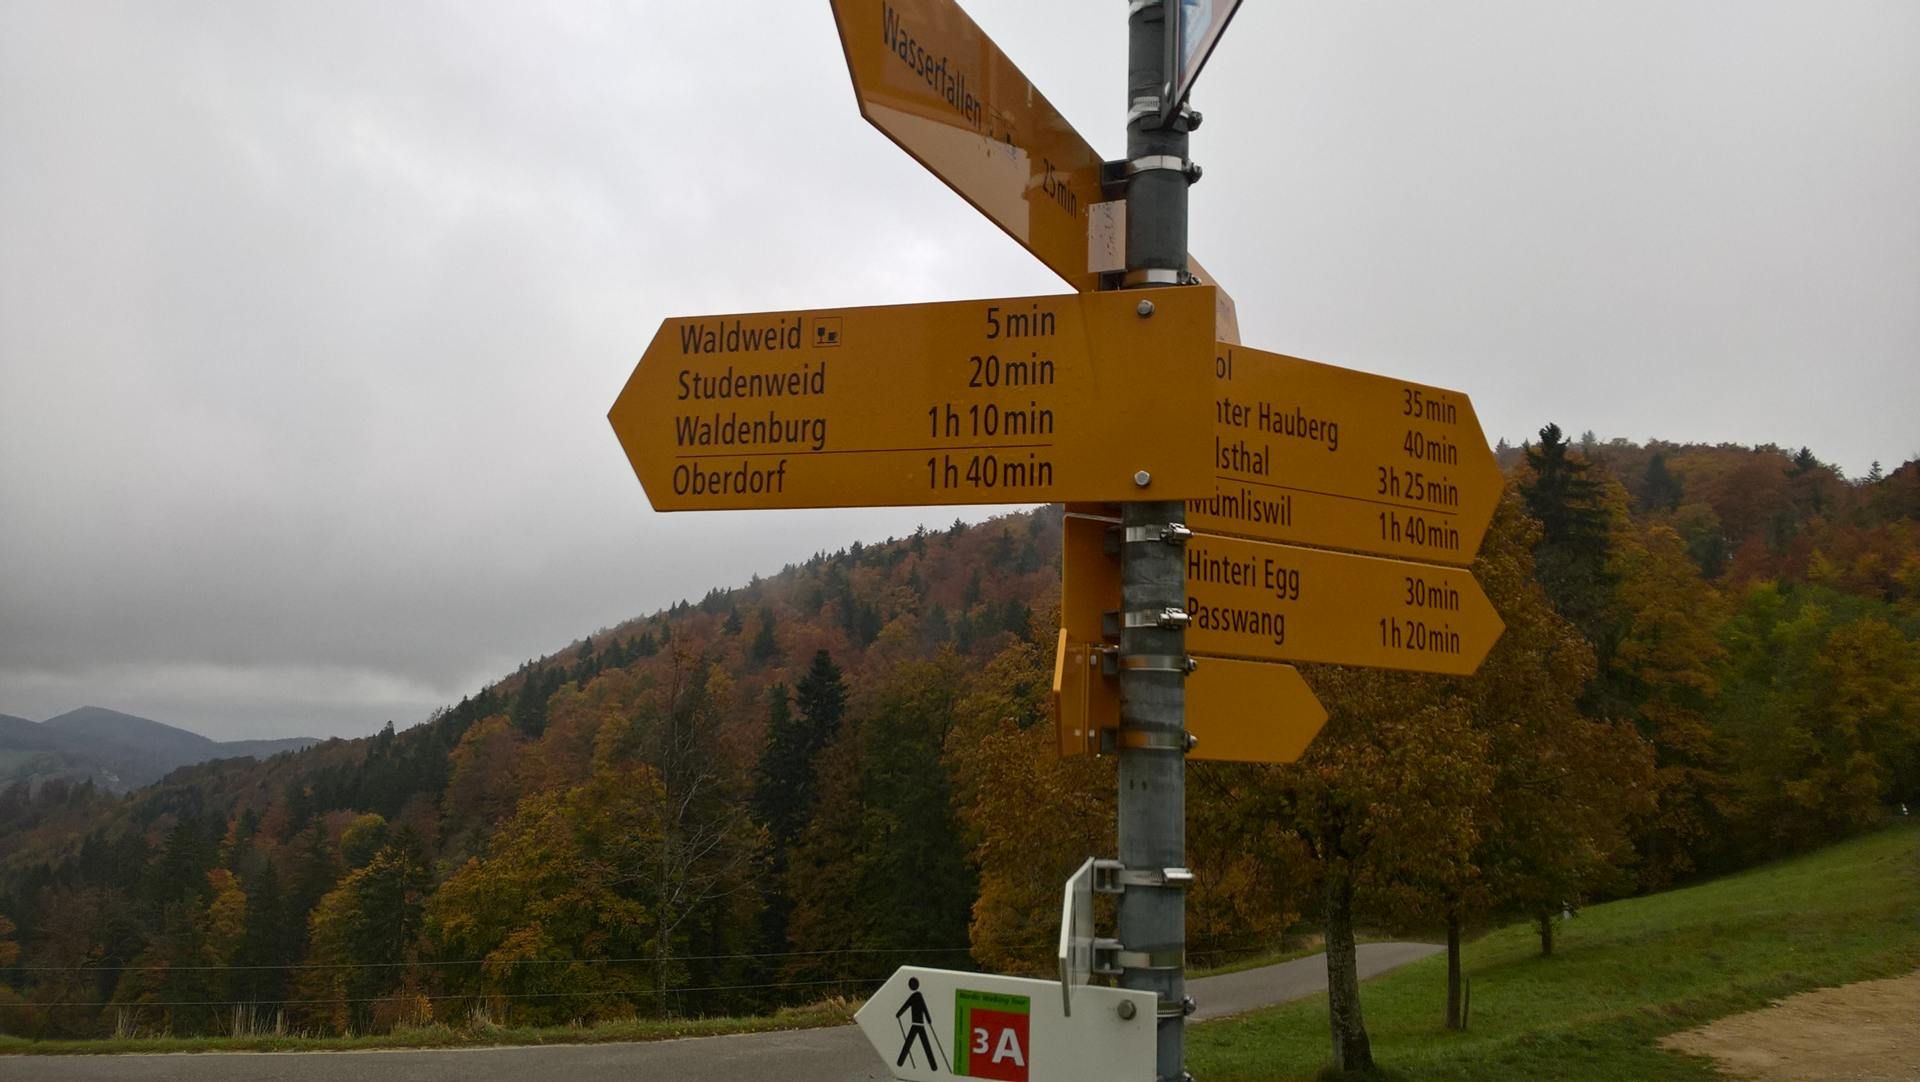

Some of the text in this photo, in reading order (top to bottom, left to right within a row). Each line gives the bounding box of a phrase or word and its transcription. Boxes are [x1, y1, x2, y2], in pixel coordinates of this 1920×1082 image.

[882, 1, 982, 130] Wasserfallen
[680, 318, 802, 354] Waldweid
[678, 362, 825, 400] Studenweid
[675, 413, 827, 449] Waldenburg
[1259, 402, 1339, 451] Hauberg
[673, 459, 786, 495] Oberdorf
[1188, 549, 1300, 601] Hinteri Egg
[1188, 597, 1285, 645] Passwang
